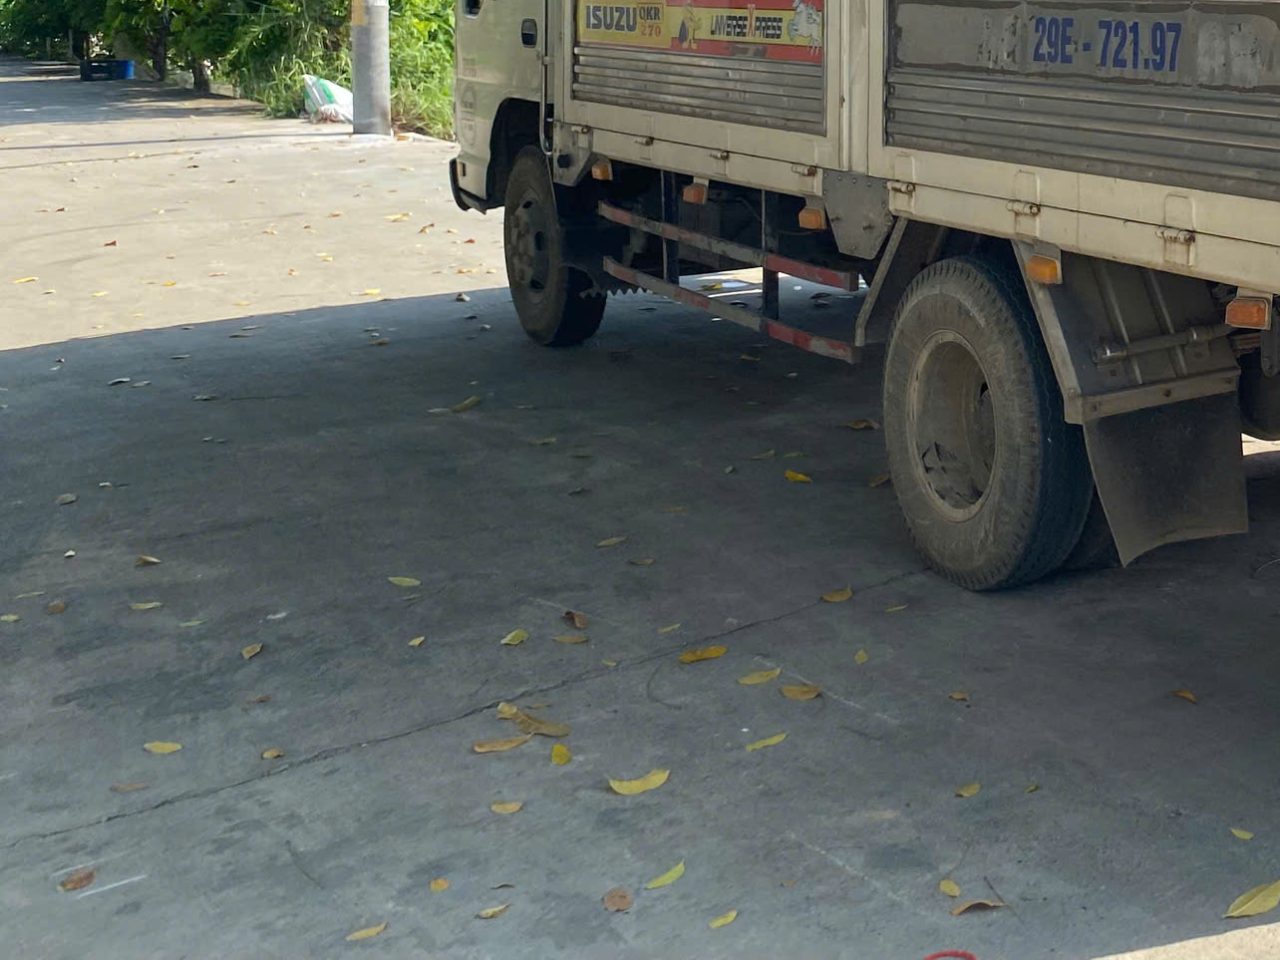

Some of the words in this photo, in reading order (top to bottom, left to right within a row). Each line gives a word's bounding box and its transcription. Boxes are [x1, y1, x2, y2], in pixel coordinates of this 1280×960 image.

[586, 5, 638, 33] ISUZU
[639, 6, 661, 21] QKR
[641, 25, 661, 38] 270
[1033, 16, 1074, 64] 29E
[1099, 19, 1183, 72] 721.97
